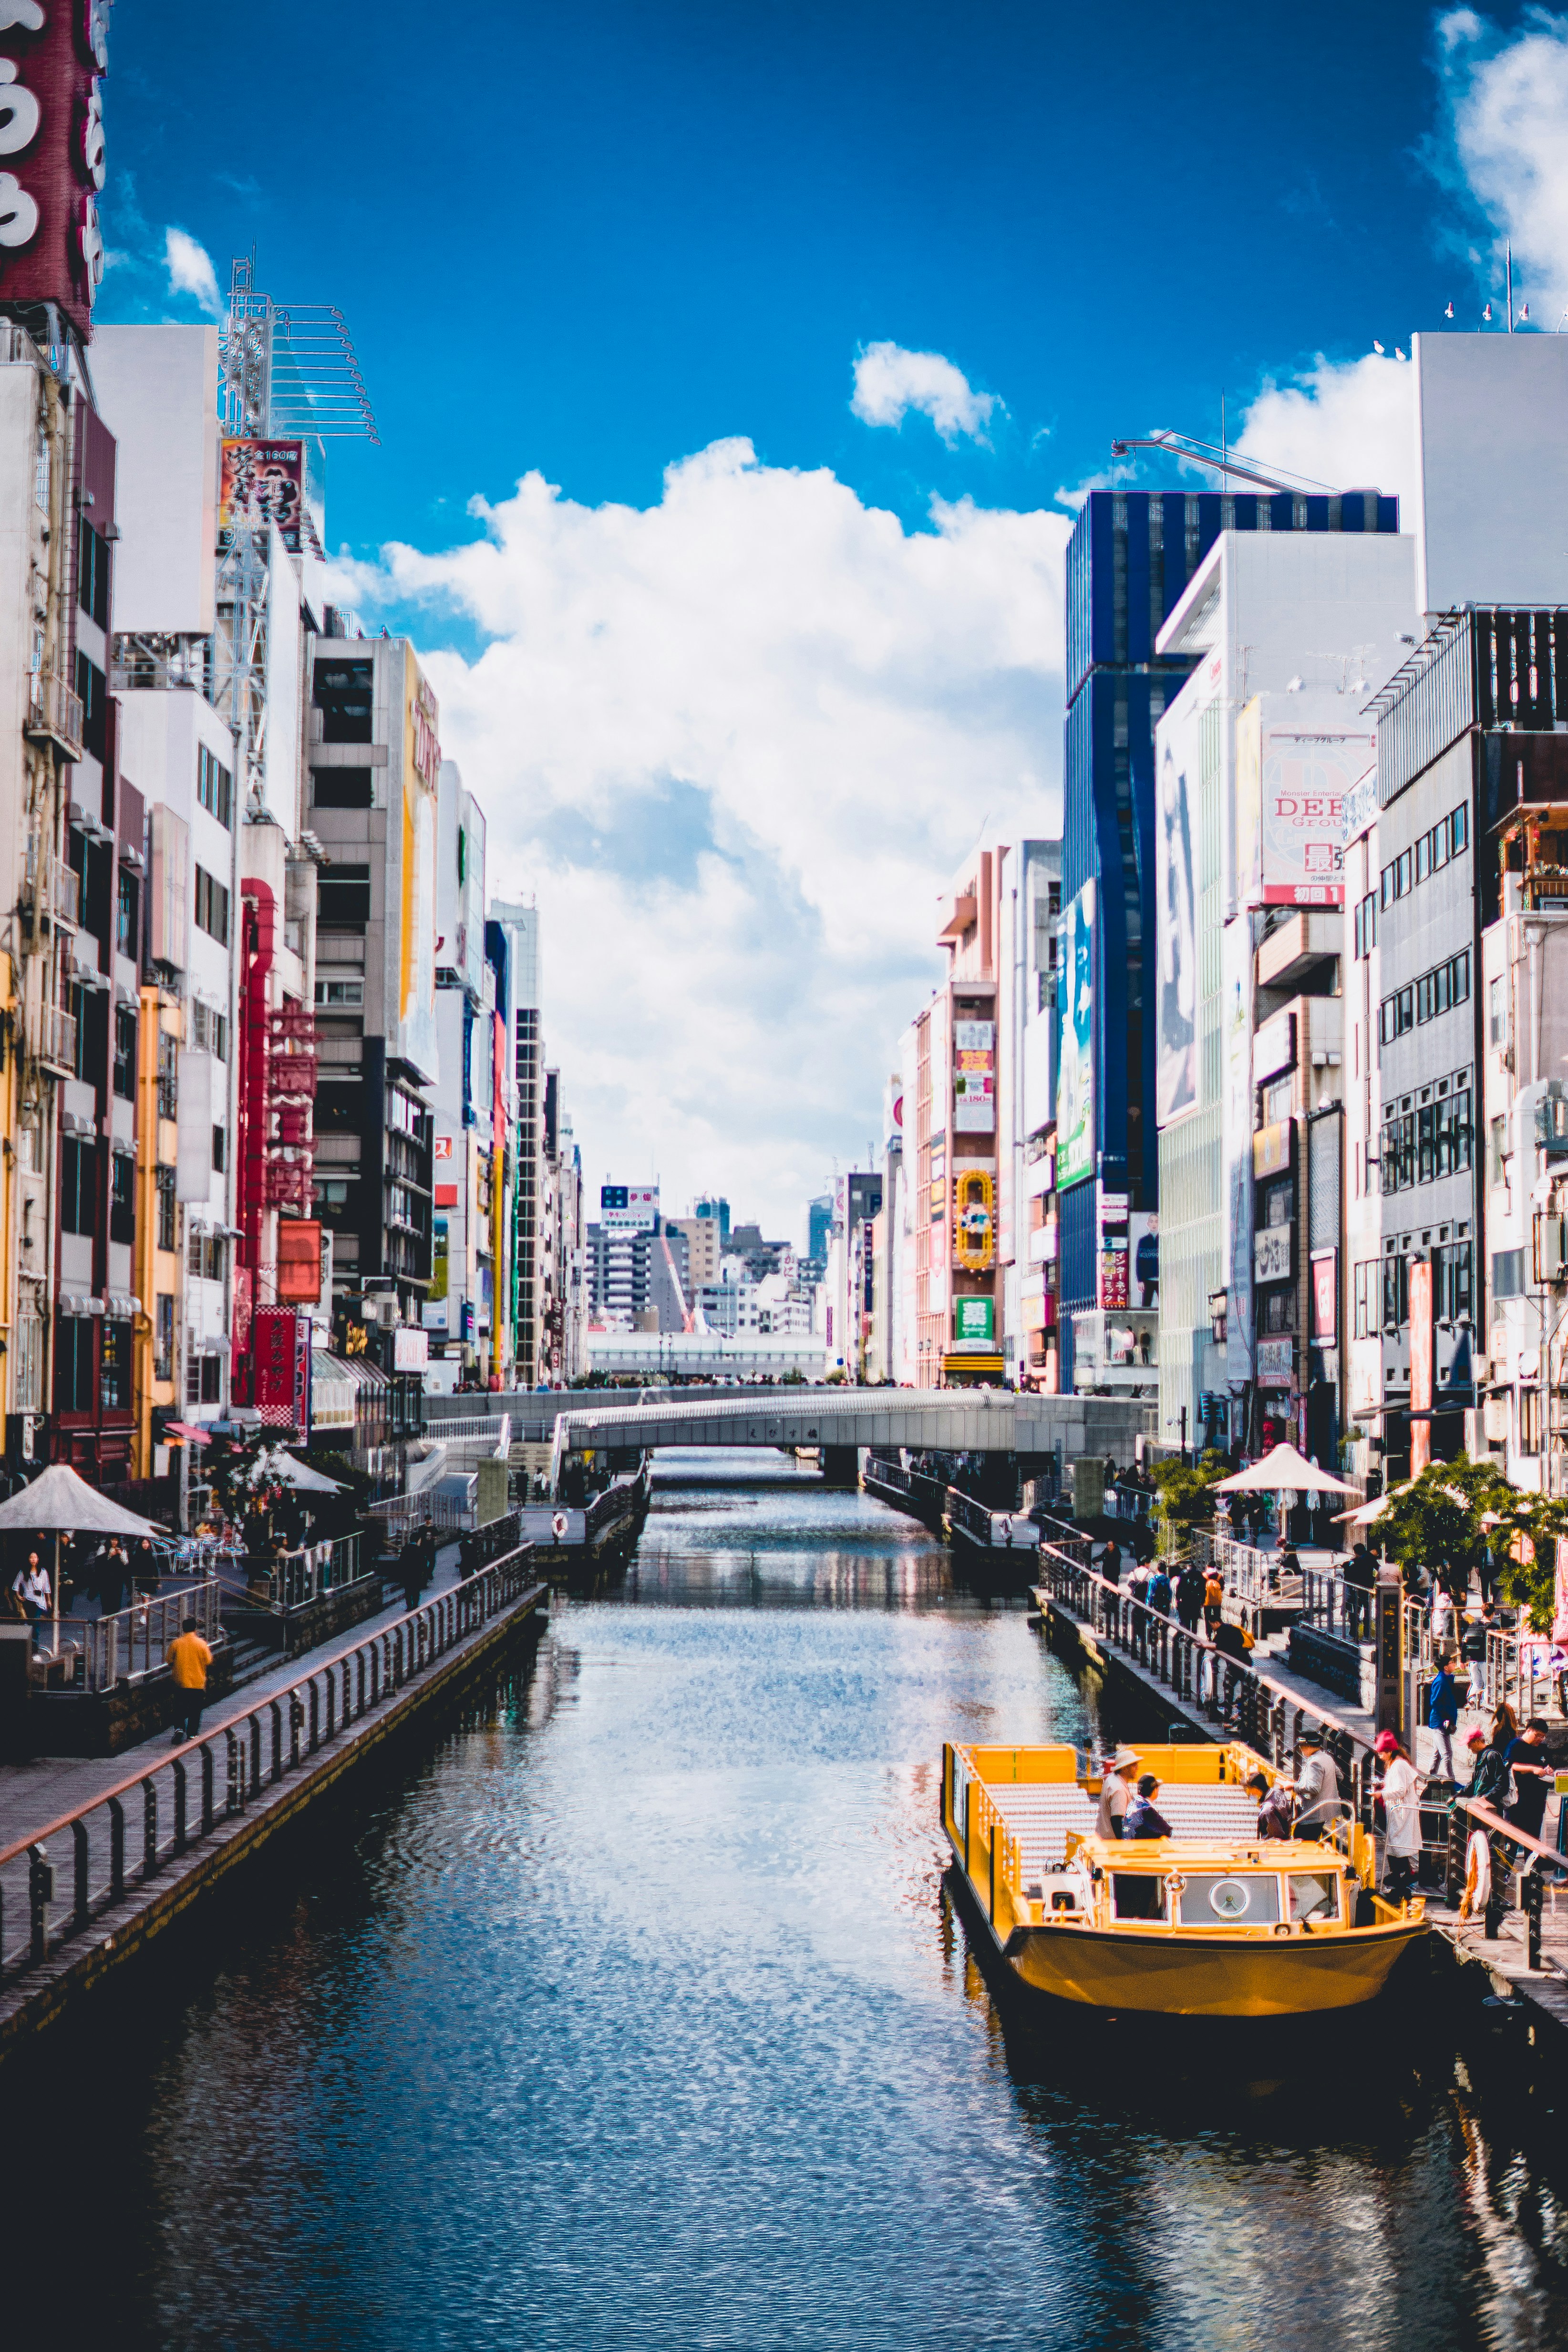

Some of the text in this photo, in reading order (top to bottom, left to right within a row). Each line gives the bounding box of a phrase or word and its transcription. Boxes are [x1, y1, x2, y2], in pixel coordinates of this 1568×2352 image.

[254, 451, 297, 461] 全160席
[784, 1254, 794, 1277] かに
[1116, 1252, 1126, 1302] インターネット
[1104, 1274, 1114, 1302] コミック
